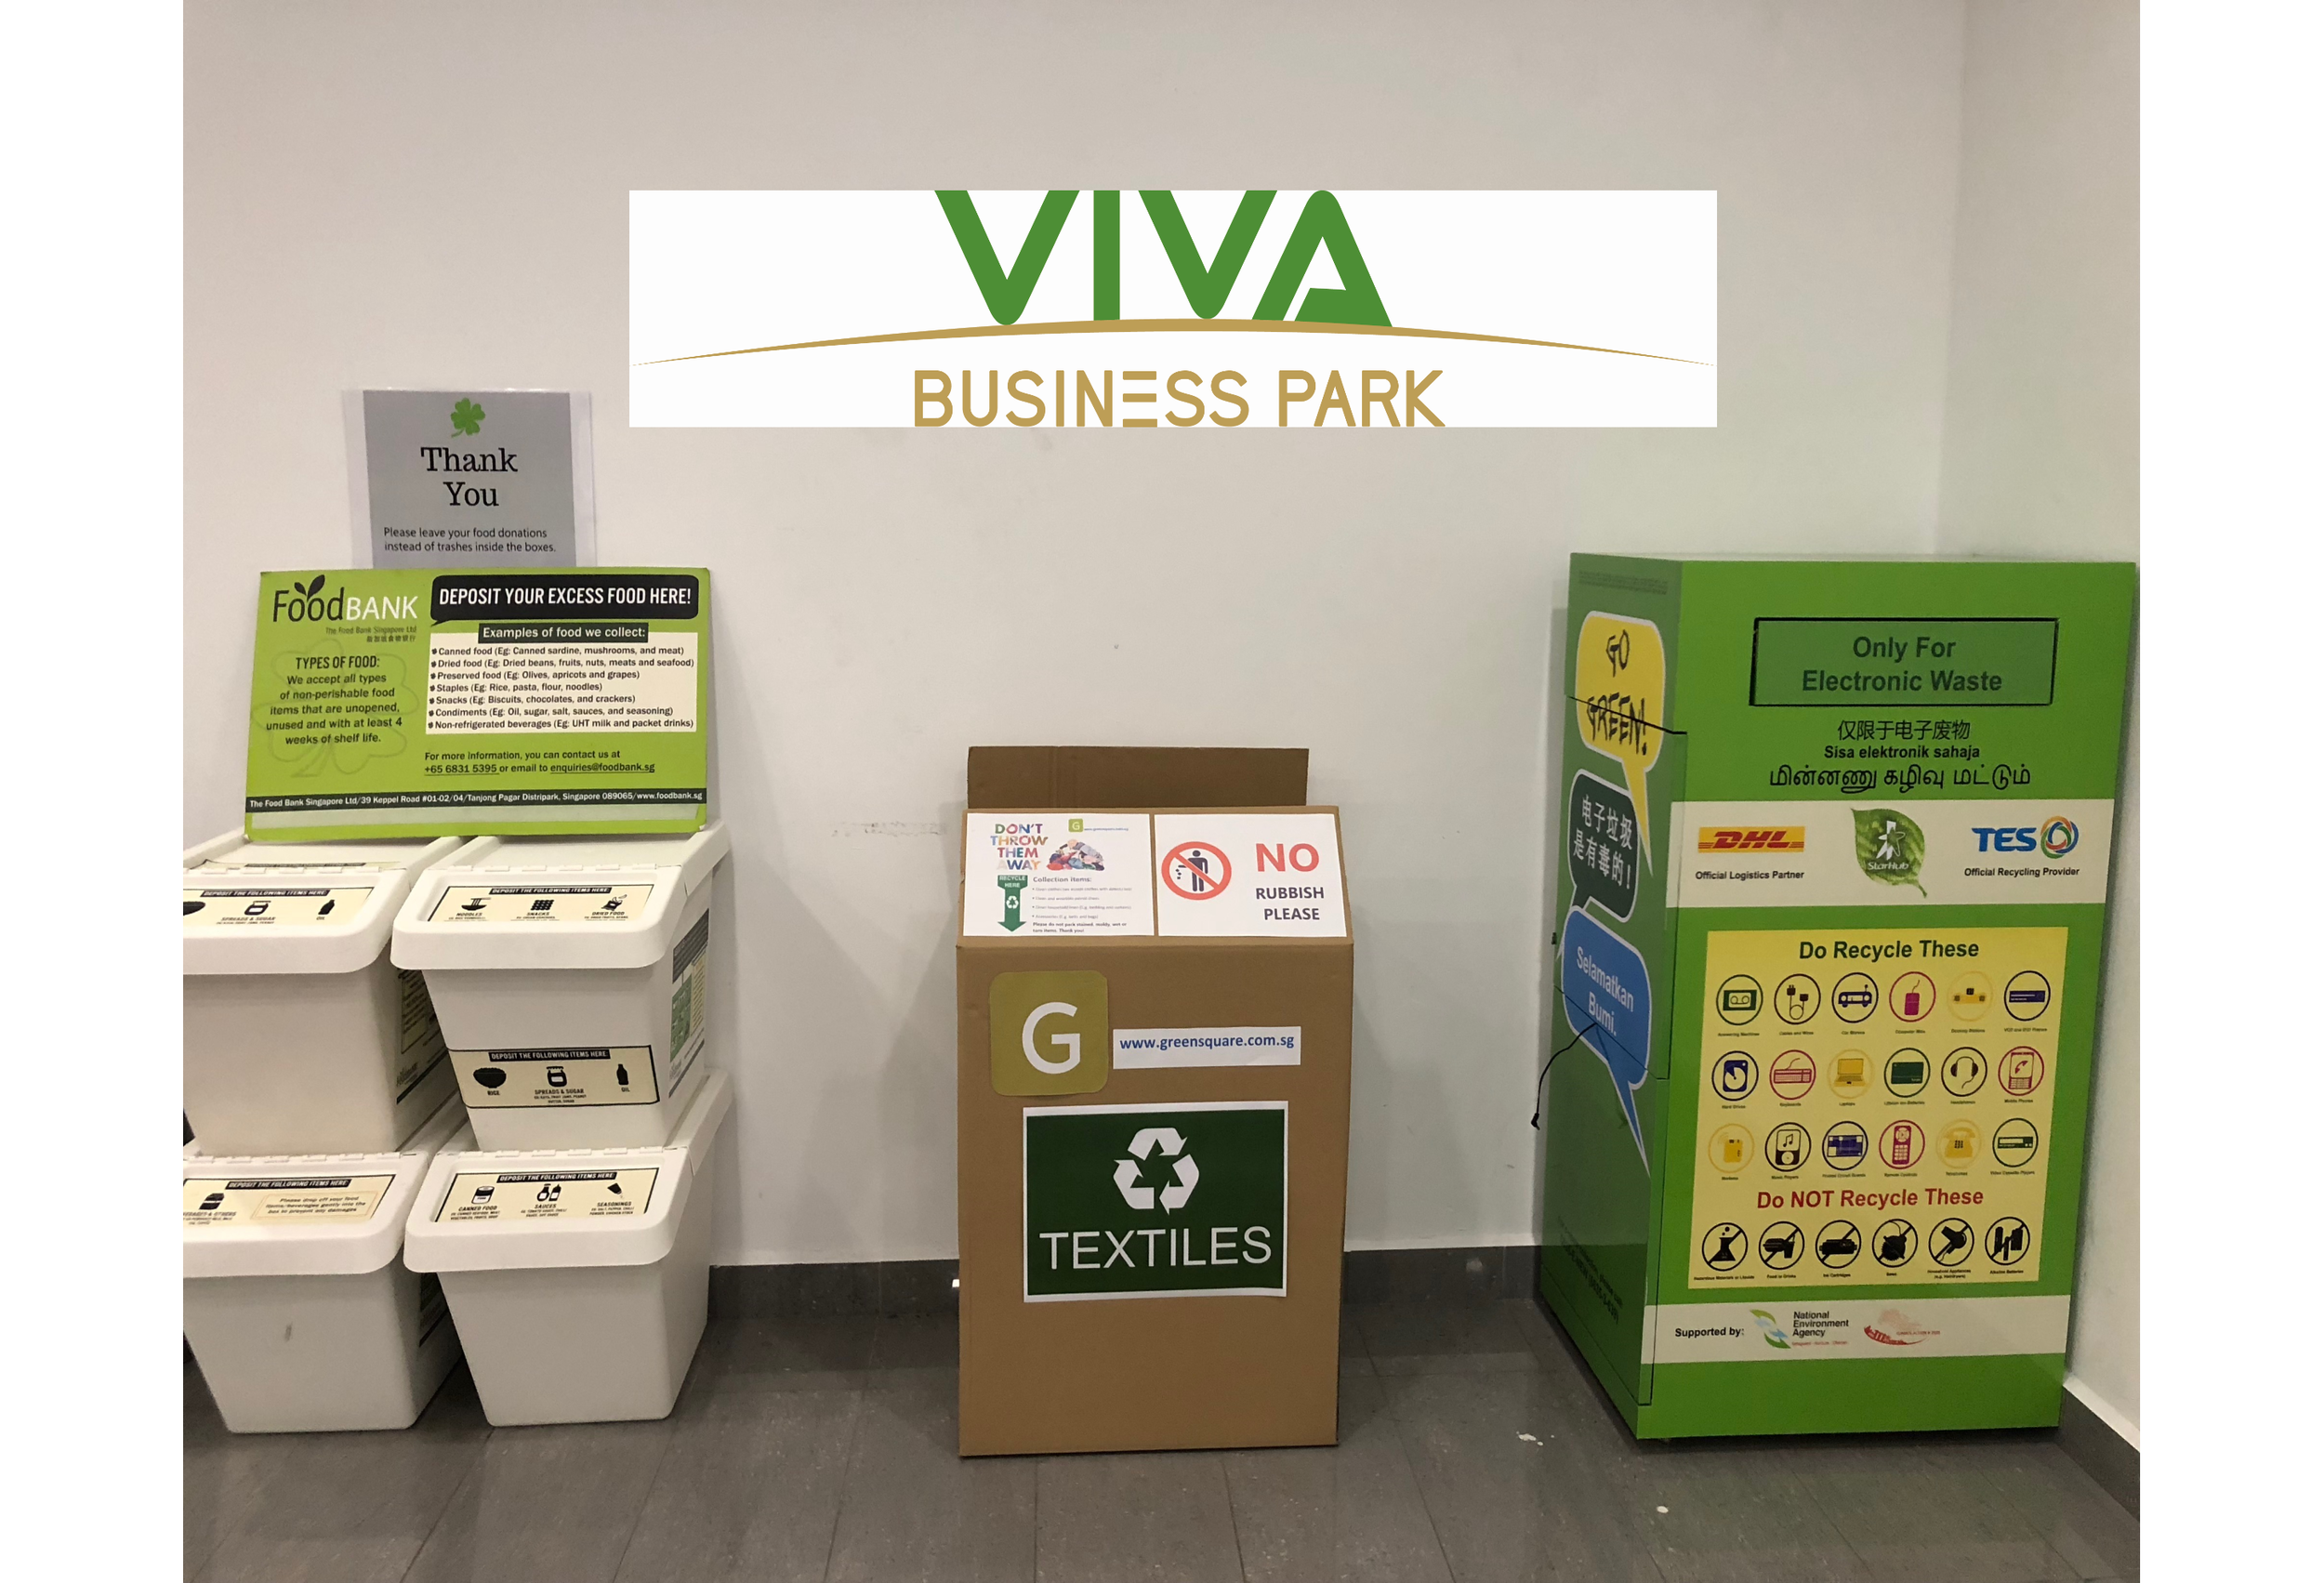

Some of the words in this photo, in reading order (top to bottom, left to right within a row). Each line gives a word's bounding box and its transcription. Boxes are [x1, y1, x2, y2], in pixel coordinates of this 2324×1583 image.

[421, 447, 518, 472] Thank
[443, 481, 498, 506] You
[384, 527, 416, 537] Please
[419, 528, 445, 537] leave
[448, 530, 470, 541] your
[473, 528, 495, 537] food
[498, 528, 547, 537] donations
[385, 542, 421, 551] instead
[424, 541, 434, 551] of
[438, 542, 472, 551] trashes
[476, 542, 504, 551] inside
[507, 542, 522, 552] the
[525, 542, 556, 552] boxes.
[440, 588, 501, 604] DEPOSIT
[506, 588, 544, 604] YOUR
[548, 587, 603, 603] EXCESS
[608, 587, 645, 603] FOOD
[651, 588, 690, 604] HERE!
[483, 627, 538, 640] Examples
[542, 627, 553, 637] of
[557, 627, 581, 637] food
[605, 627, 645, 637] collect:
[495, 647, 510, 656] (Eg:
[658, 647, 684, 655] meat)
[1605, 629, 1630, 678] GO
[1854, 637, 1908, 662] Only
[1917, 637, 1956, 657] For
[296, 656, 329, 669] TYPES
[333, 656, 346, 668] OF
[349, 656, 379, 667] FOOD:
[287, 676, 303, 684] We
[307, 675, 340, 685] accept
[344, 674, 355, 683] all
[359, 675, 387, 684] types
[504, 671, 519, 680] (Eg:
[552, 671, 587, 679] apricots
[608, 671, 640, 679] grapes)
[1802, 670, 1921, 691] Electronic
[1931, 670, 2001, 691] Waste
[280, 691, 290, 700] of
[293, 689, 368, 700] non-perishable
[372, 688, 394, 697] food
[435, 720, 505, 730] Non-refrigerated
[508, 720, 551, 729] beverages
[553, 719, 569, 729] (Eg:
[632, 719, 661, 729] packet
[664, 719, 693, 728] drinks)
[1838, 719, 1970, 741] 仅限于电子废物
[285, 735, 318, 744] weeks
[321, 734, 331, 744] of
[335, 733, 359, 743] shelf
[363, 732, 380, 742] life.
[469, 751, 522, 759] information,
[1824, 745, 1854, 759] Sisa
[1859, 745, 1929, 758] elektronik
[1934, 745, 1979, 760] sahaja
[472, 764, 497, 772] 5395
[550, 763, 655, 773] enquiries@foodbank.sg
[1770, 764, 1877, 794] மின்னணு
[1884, 764, 1944, 793] கழிவு
[1954, 764, 2030, 790] மட்டும்
[1582, 794, 1632, 850] 电子垃圾
[990, 836, 1049, 846] THROW
[1712, 831, 1790, 849] DHL
[1972, 827, 2037, 852] TES
[997, 848, 1038, 858] THEM
[1256, 844, 1319, 872] NO
[997, 860, 1041, 871] AWAY
[1868, 862, 1908, 871] StarHub
[1998, 868, 2040, 877] Recycling
[2043, 867, 2080, 876] Provider
[1696, 871, 1726, 879] Official
[1730, 871, 1769, 881] Logistics
[1256, 887, 1324, 899] RUBBISH
[1264, 908, 1319, 920] PLEASE
[1800, 942, 1826, 958] Do
[1834, 941, 1912, 961] Recycle
[1920, 941, 1978, 957] These
[1577, 946, 1633, 1012] Selamatkan
[1589, 991, 1617, 1036] Bumi.
[1023, 1002, 1080, 1074] G
[1120, 1036, 1295, 1051] www.greensquare.com.sg
[1758, 1192, 1784, 1208] Do
[1791, 1191, 1834, 1207] NOT
[1841, 1189, 1918, 1210] Recycle
[1925, 1188, 1983, 1205] These
[1039, 1225, 1272, 1270] TEXTILES
[1794, 1311, 1829, 1319] National
[1675, 1327, 1725, 1339] Supported
[1729, 1327, 1744, 1337] by:
[1792, 1329, 1826, 1339] Agency
